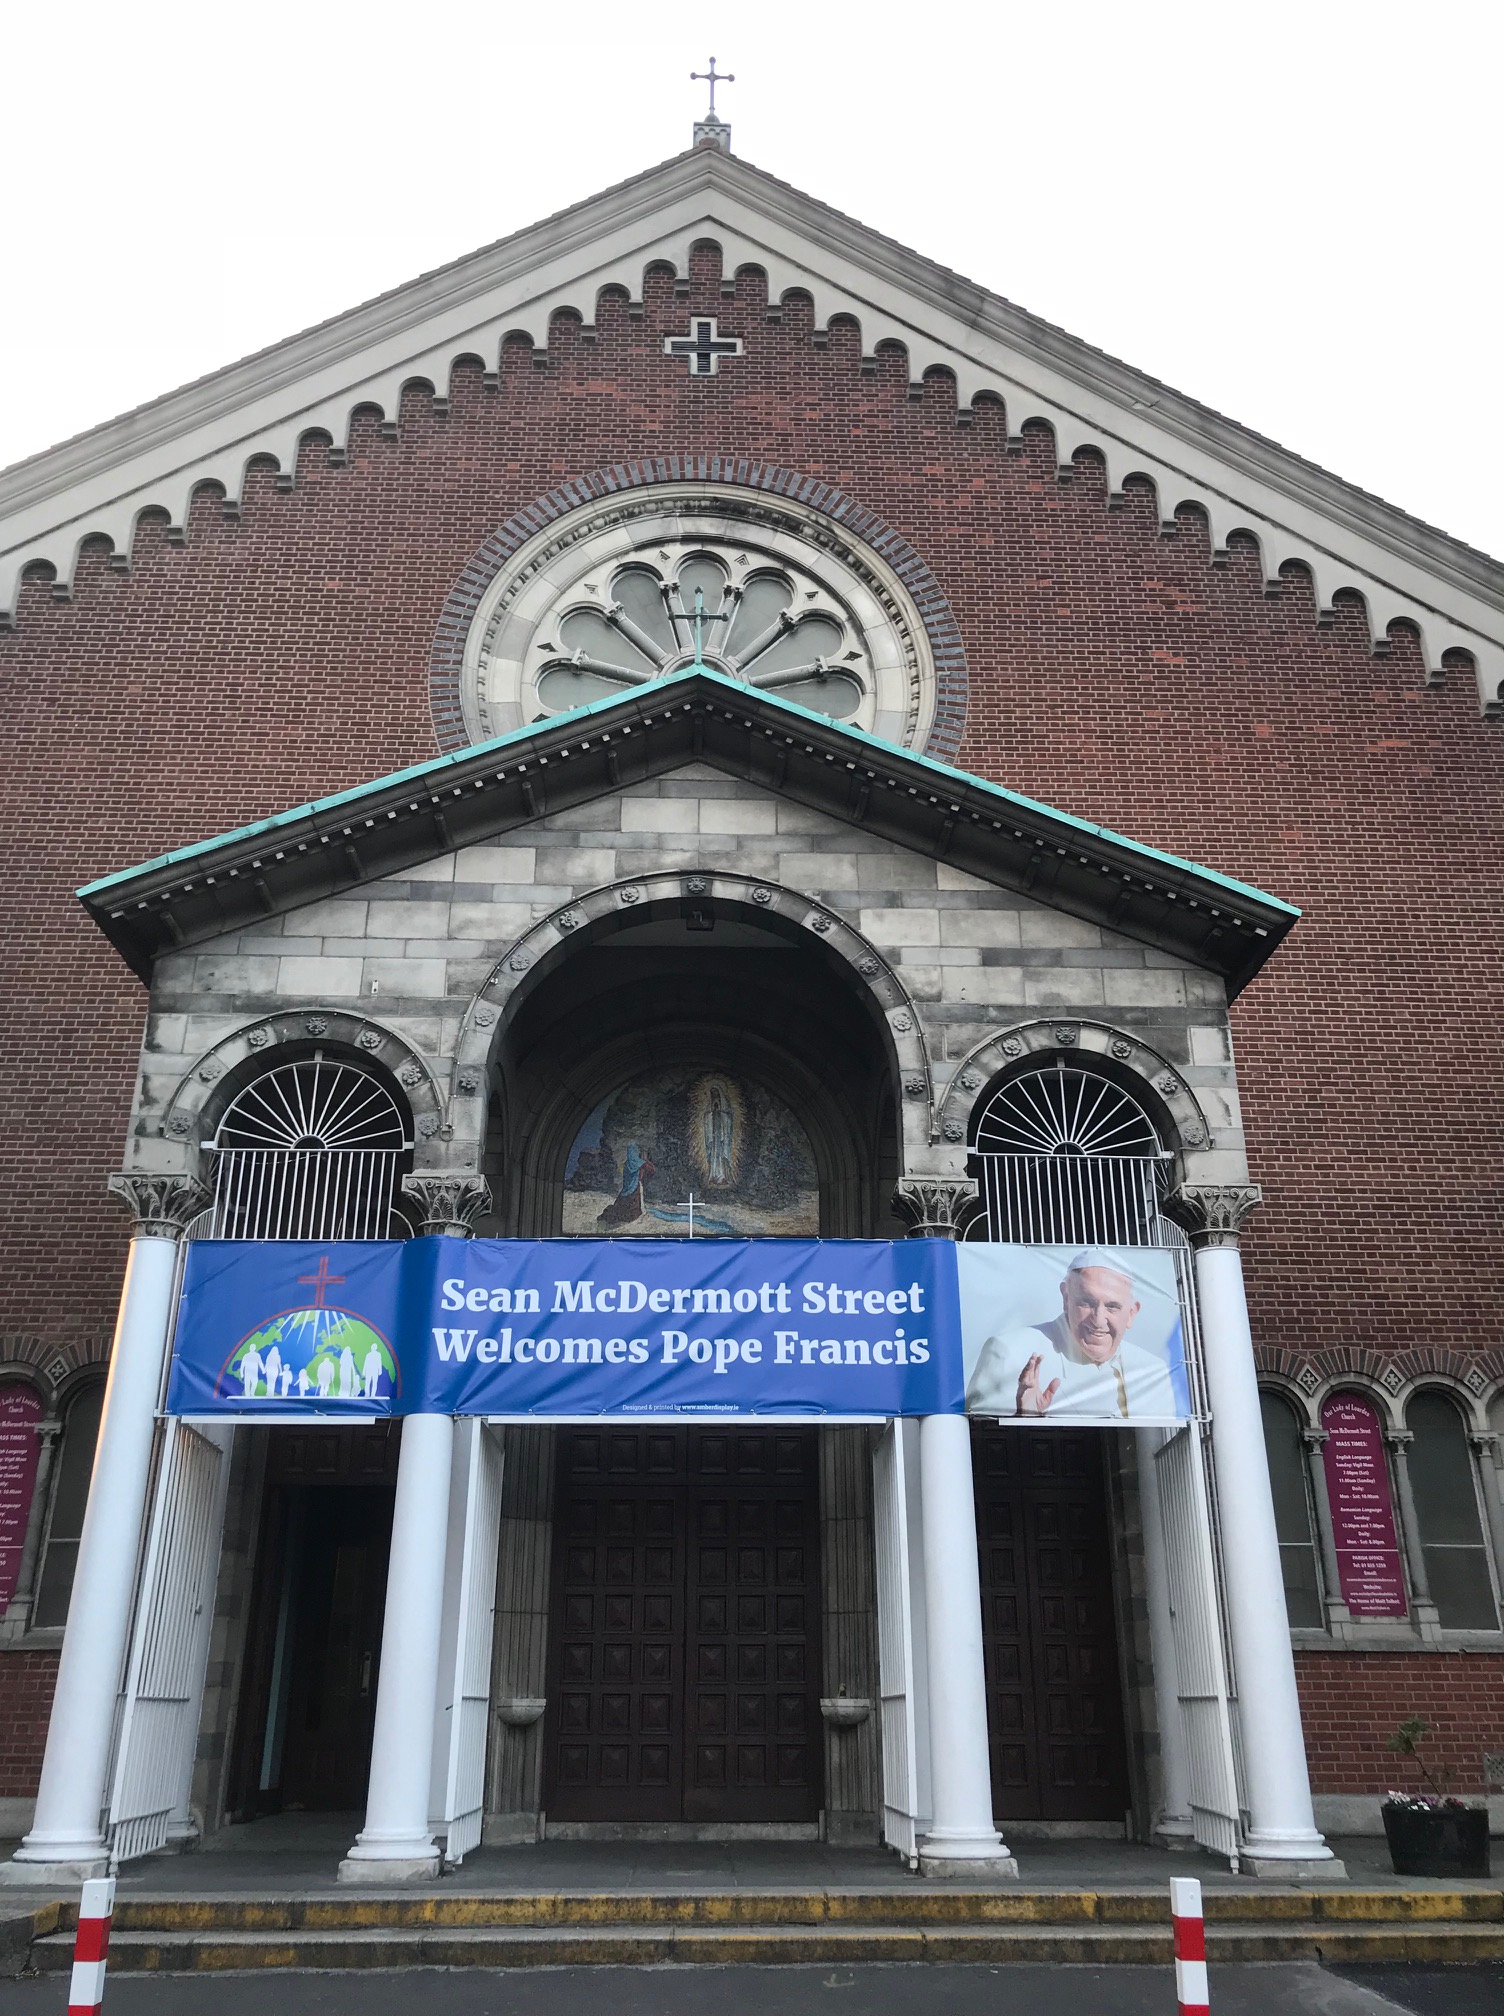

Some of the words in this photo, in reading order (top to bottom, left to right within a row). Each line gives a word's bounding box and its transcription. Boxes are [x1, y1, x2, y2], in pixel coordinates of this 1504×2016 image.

[441, 1279, 540, 1313] Sean
[551, 1280, 792, 1314] McDermott
[803, 1282, 926, 1315] Street
[432, 1328, 649, 1364] Welcomes
[661, 1330, 763, 1374] Pope
[774, 1329, 930, 1366] Francis
[622, 1404, 648, 1413] Designed
[653, 1404, 674, 1412] printed
[682, 1404, 739, 1412] www.amberdisplay.ie
[1332, 1404, 1345, 1412] Lady
